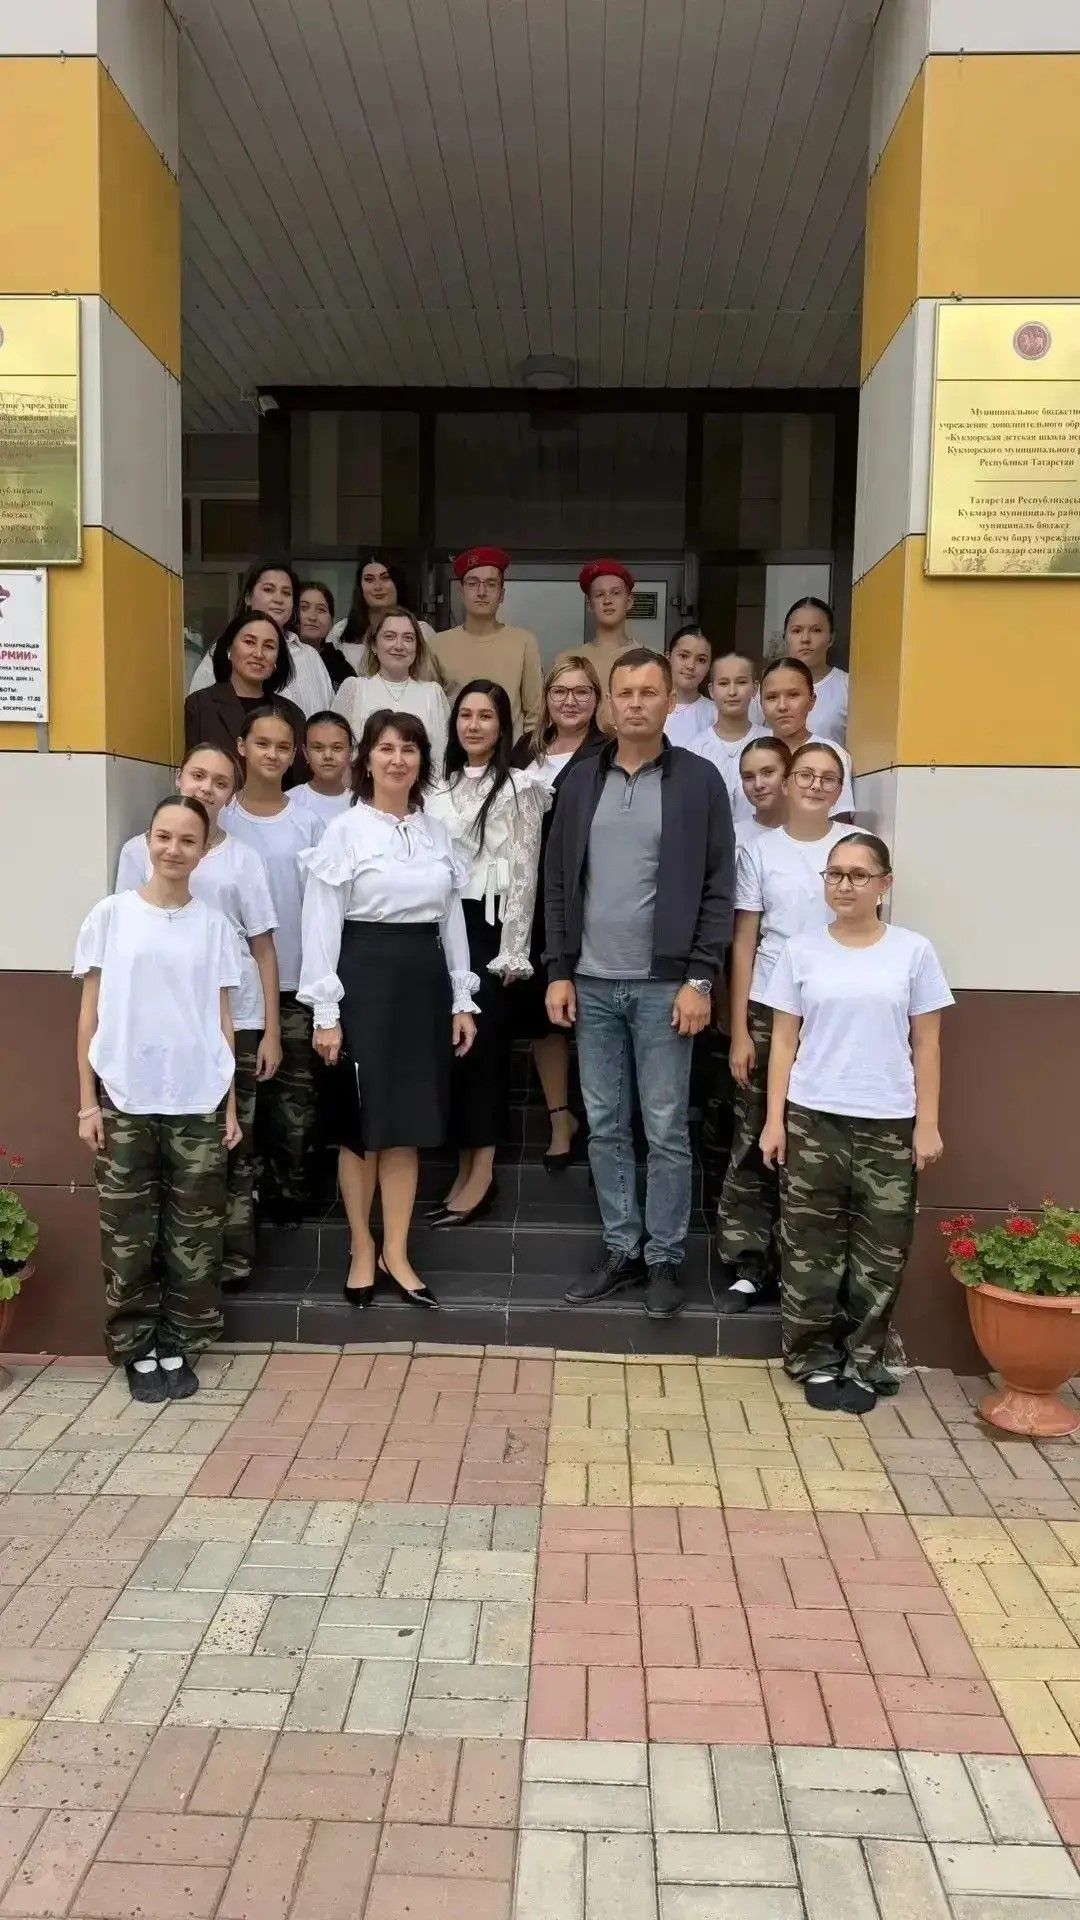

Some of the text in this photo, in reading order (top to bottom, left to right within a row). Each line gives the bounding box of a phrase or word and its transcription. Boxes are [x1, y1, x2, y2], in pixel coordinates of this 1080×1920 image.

[970, 408, 1039, 417] Муниципальное
[939, 422, 989, 430] учреждение
[991, 421, 1063, 429] дополнительного
[947, 446, 1002, 456] Кукморского
[1004, 447, 1076, 455] муниципального
[979, 458, 1075, 468] Республики Татарстан
[970, 496, 1015, 506] Татарстан
[958, 508, 997, 518] Кукмара
[979, 521, 1070, 531] муниципаль бюджет
